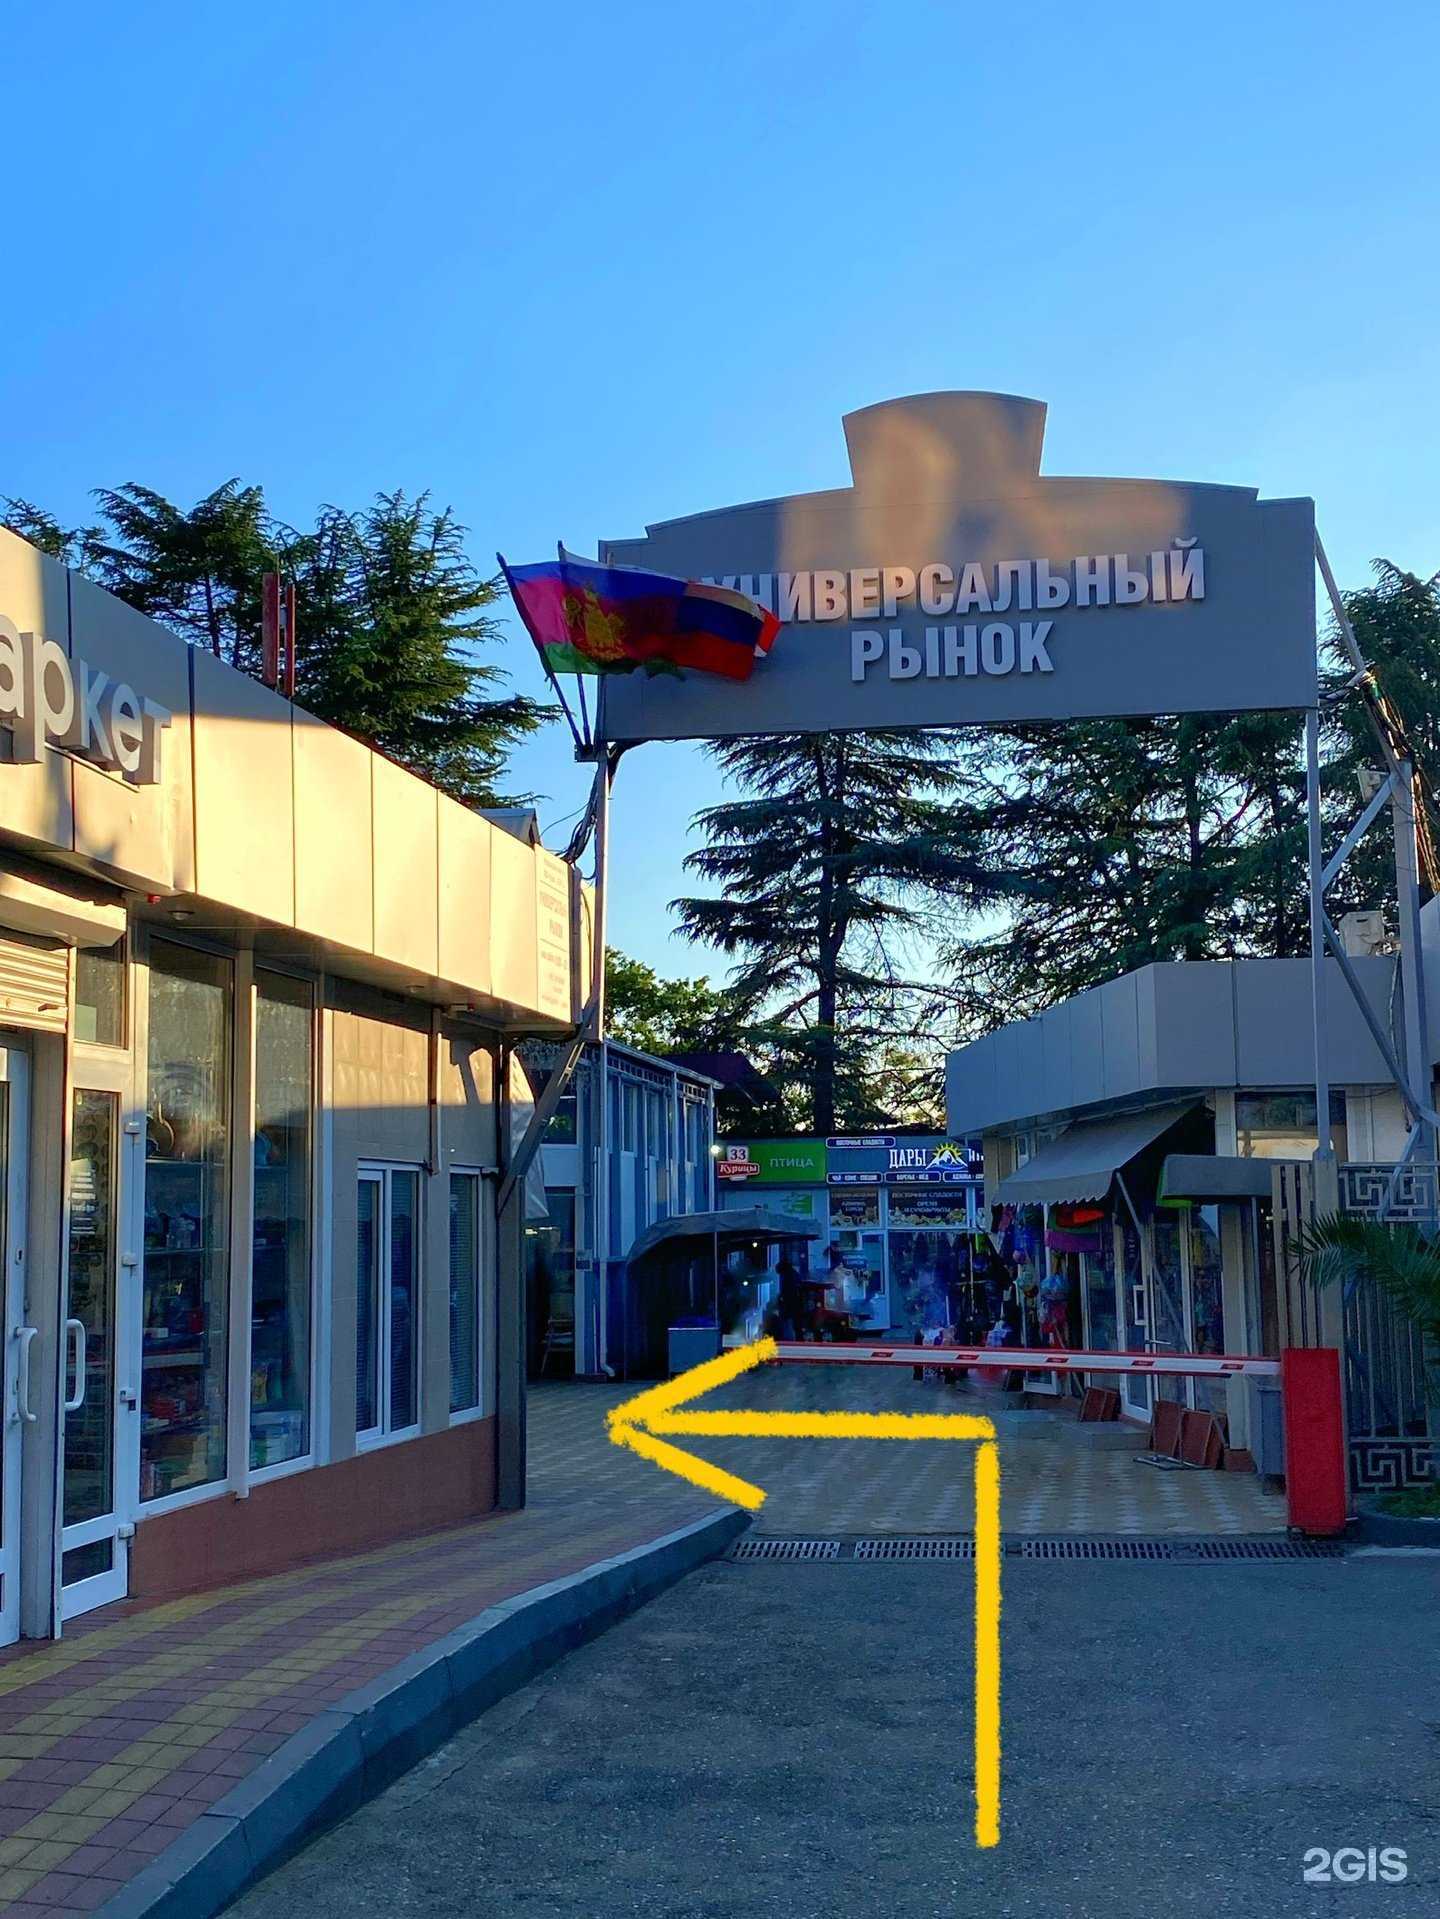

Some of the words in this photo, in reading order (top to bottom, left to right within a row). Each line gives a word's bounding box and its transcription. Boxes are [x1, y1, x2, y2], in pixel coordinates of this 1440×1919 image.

[851, 620, 1055, 682] РЫНОК
[730, 1148, 746, 1161] 33
[889, 1149, 927, 1169] ДАРЫ
[720, 1164, 757, 1174] Курицы
[769, 1158, 814, 1168] ПТИЦА
